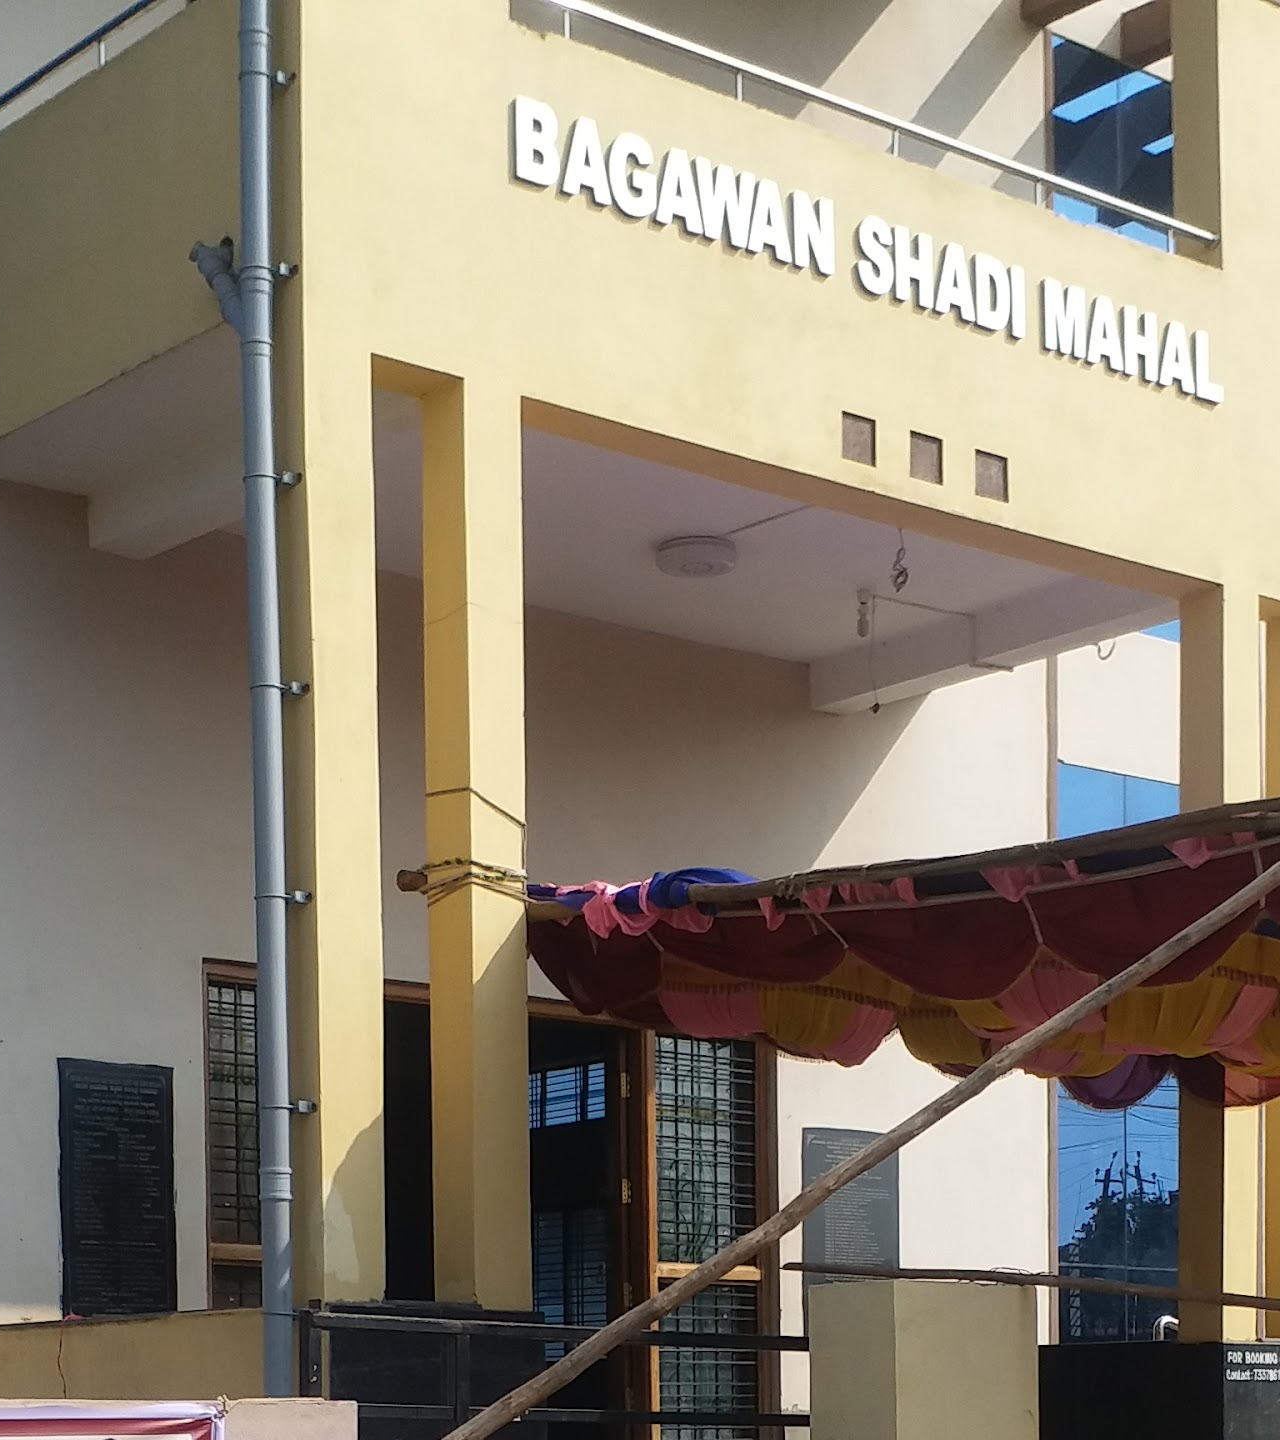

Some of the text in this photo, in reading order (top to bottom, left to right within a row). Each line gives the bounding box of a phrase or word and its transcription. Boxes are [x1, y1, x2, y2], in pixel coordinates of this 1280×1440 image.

[510, 95, 1224, 405] BAGAWAN SHADI MAHAL
[1226, 1350, 1244, 1364] FOR
